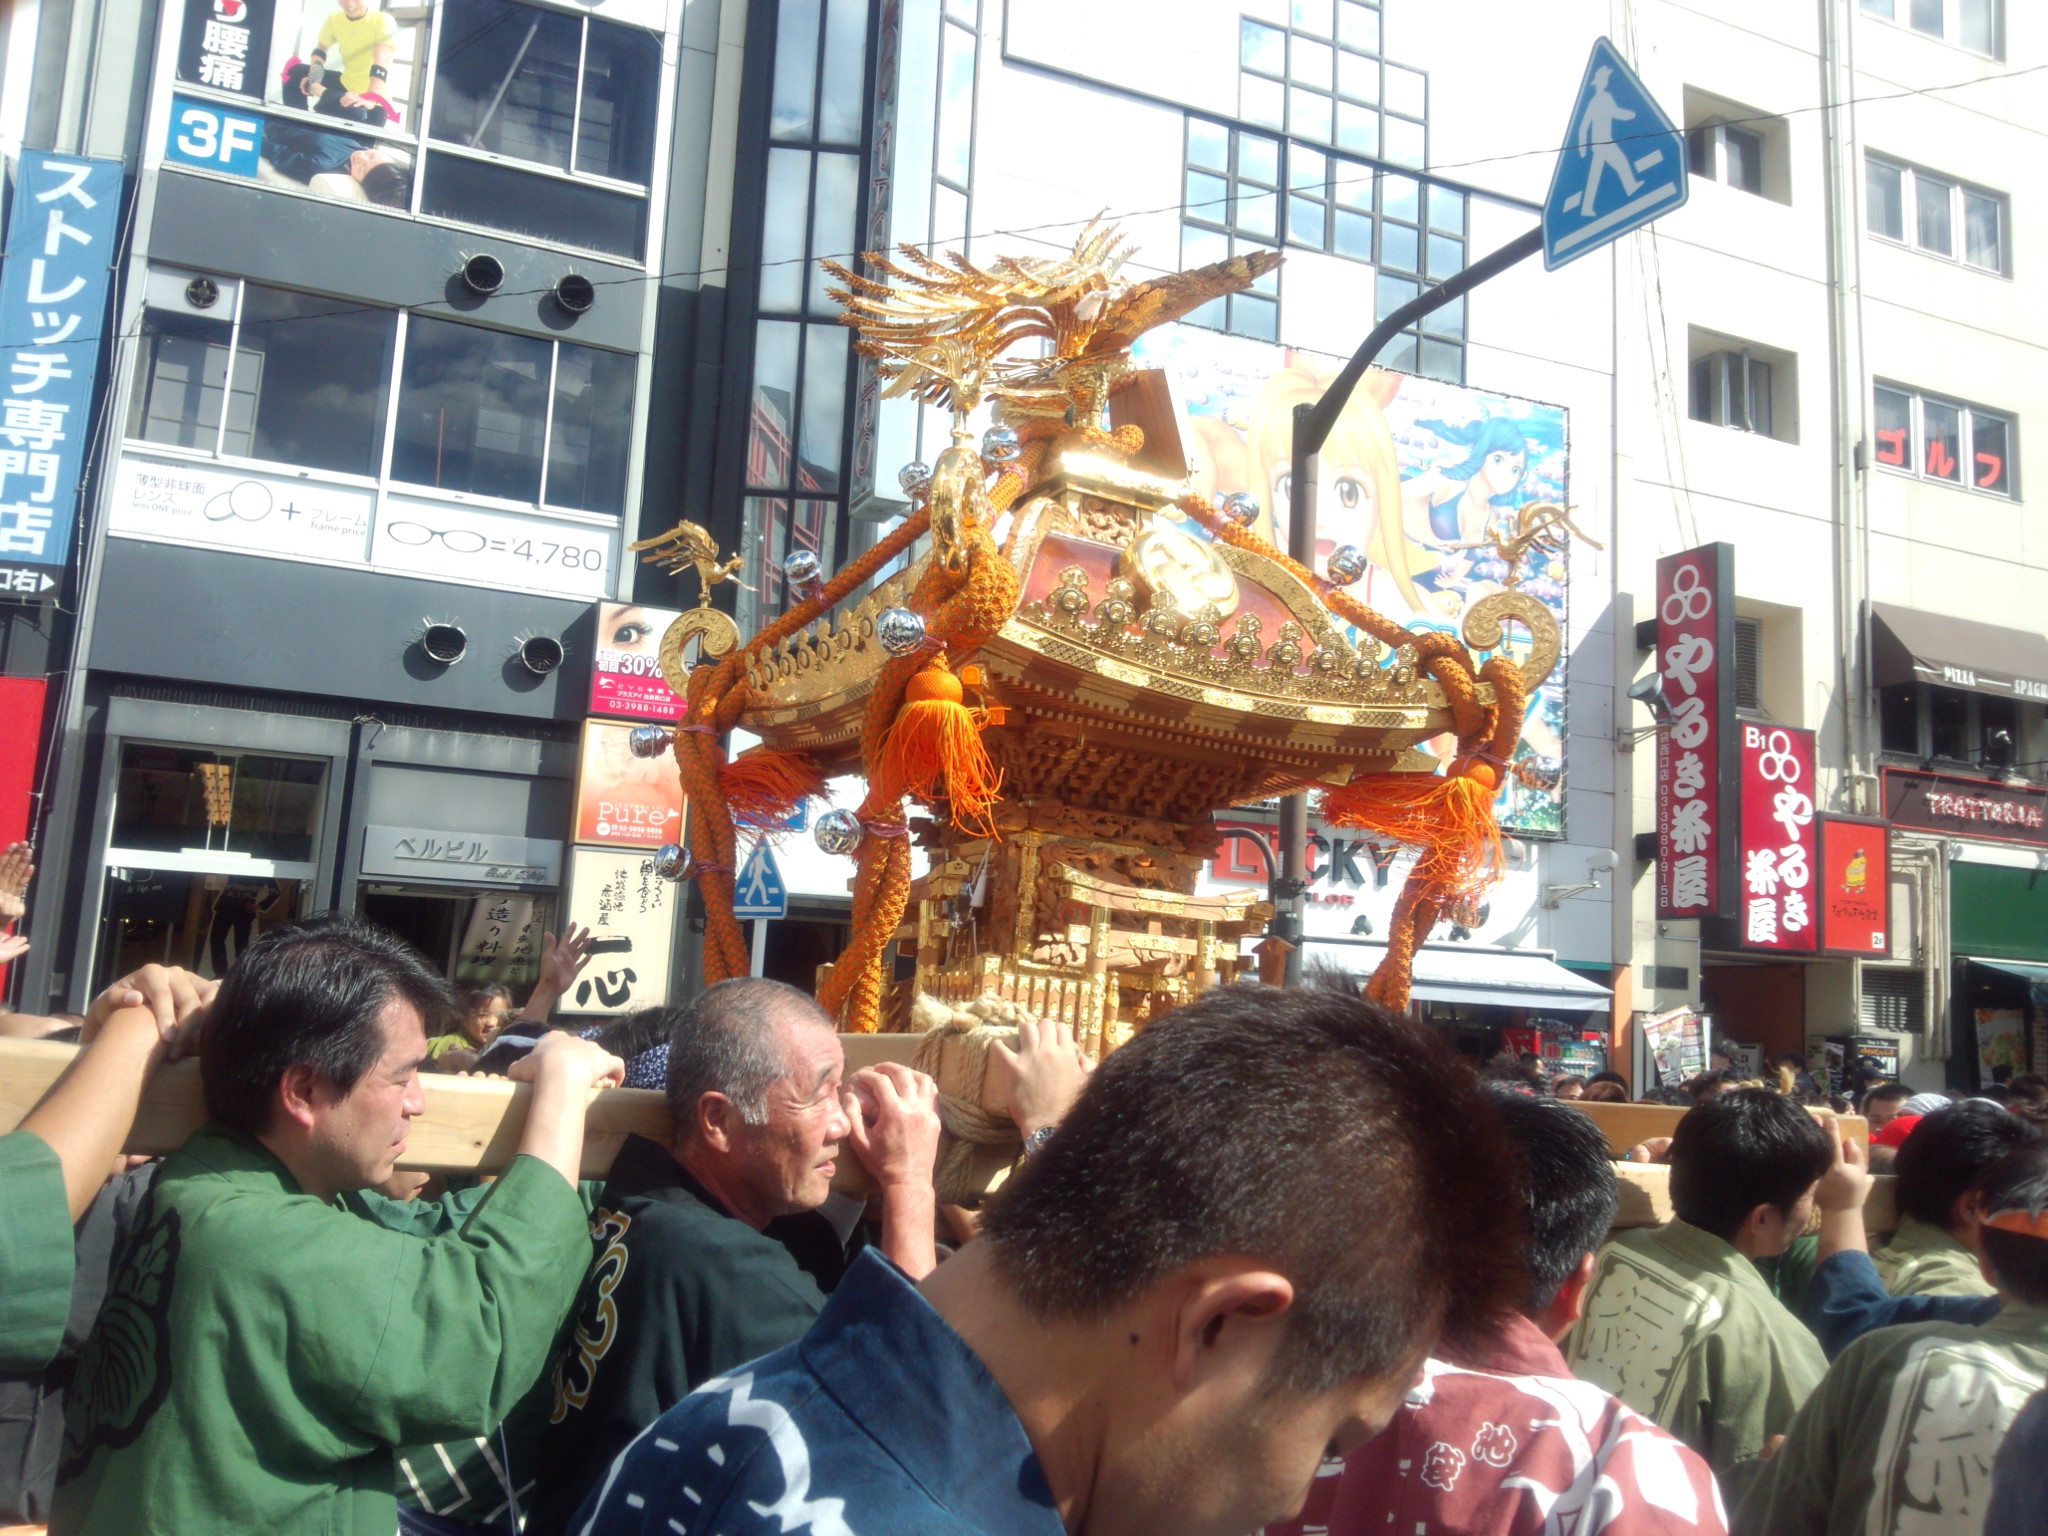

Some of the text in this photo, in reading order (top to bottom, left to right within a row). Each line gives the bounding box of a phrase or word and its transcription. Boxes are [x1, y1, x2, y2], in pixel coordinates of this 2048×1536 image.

[177, 109, 256, 163] 3F
[0, 160, 98, 555] ストレッチ専門店
[621, 653, 663, 678] 30%
[1943, 666, 1977, 687] PIZZA
[1746, 727, 1767, 749] B1
[1664, 633, 1715, 909] やるき茶屋
[597, 801, 667, 826] Pure
[1926, 792, 2045, 829] TRATTORIA
[395, 838, 488, 862] ベルビル
[1229, 834, 1400, 887] LCKY
[1745, 848, 1779, 944] 茶屋
[470, 899, 512, 967] 造り料理
